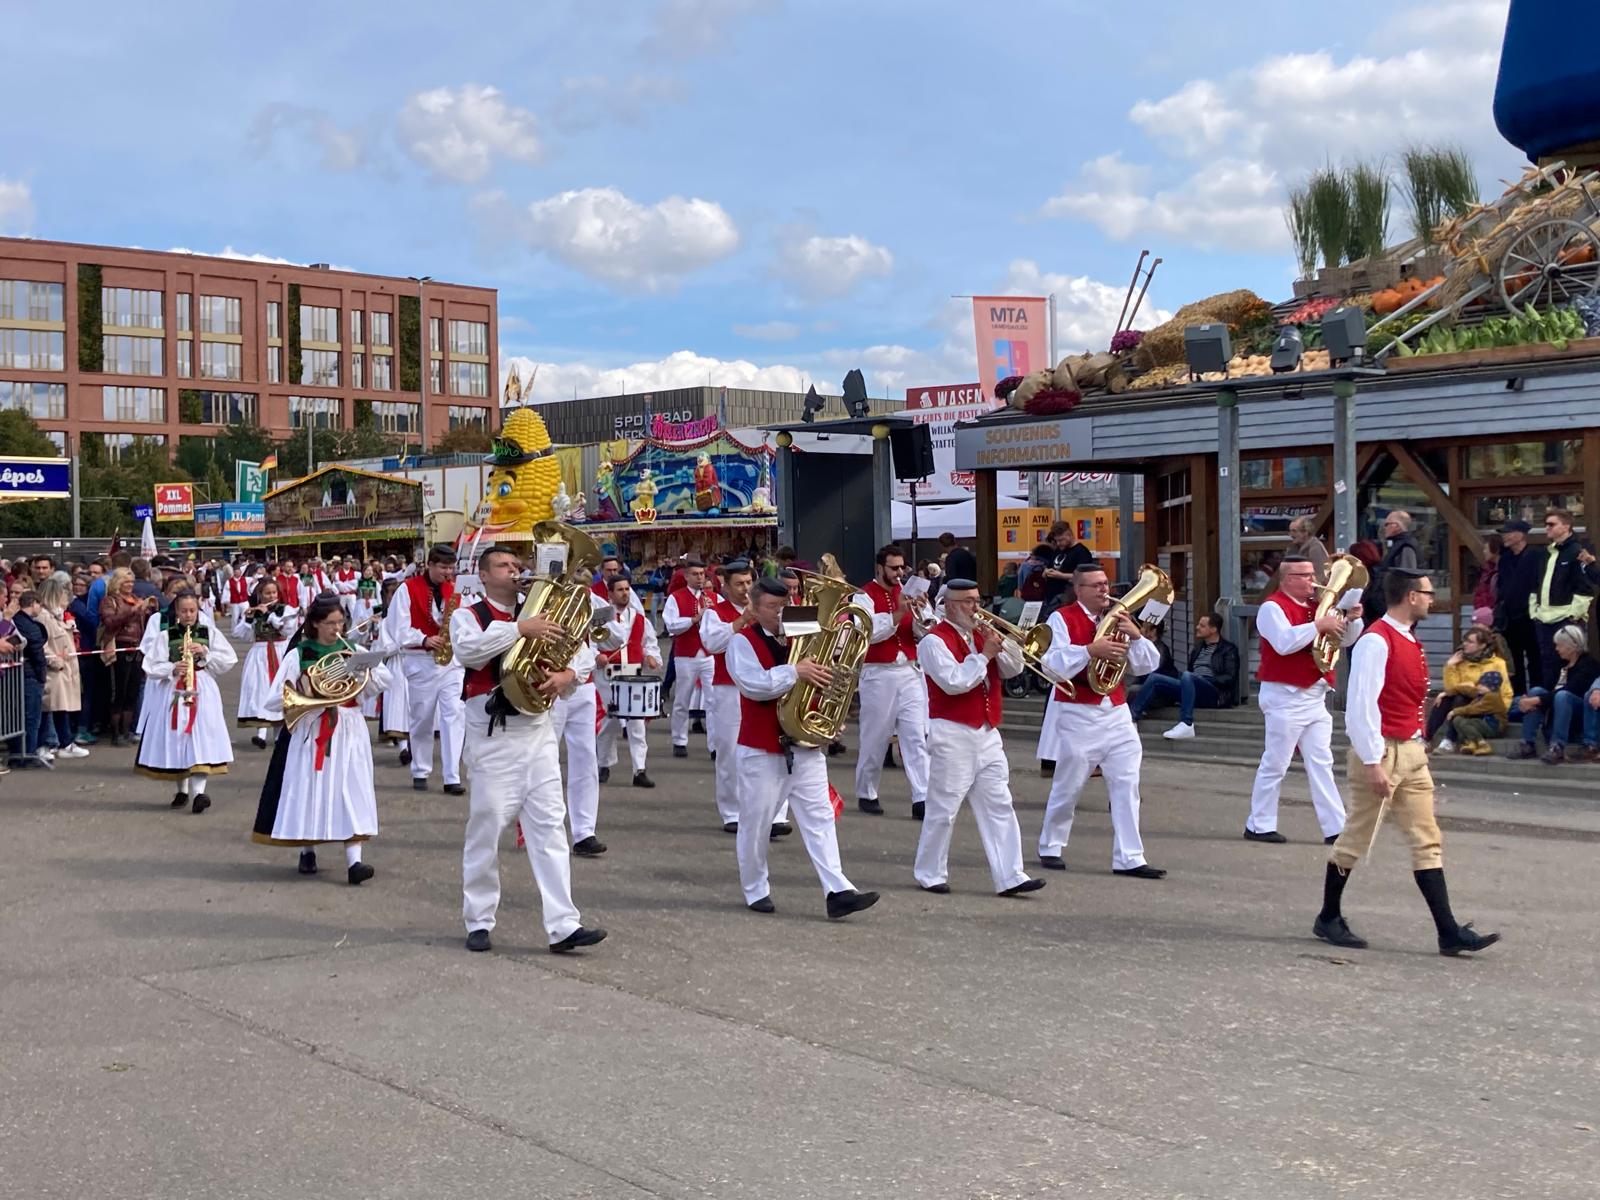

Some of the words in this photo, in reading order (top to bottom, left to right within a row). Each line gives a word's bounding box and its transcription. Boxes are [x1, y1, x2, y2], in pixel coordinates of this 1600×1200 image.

[937, 388, 982, 407] WASEN
[614, 410, 693, 428] SPOBAD
[614, 430, 646, 441] NECK
[985, 424, 1061, 445] SOUVENIRS
[976, 443, 1072, 465] INFORMATION
[0, 467, 45, 488] êpes
[165, 490, 182, 501] XXL
[158, 502, 192, 514] Pommes
[231, 511, 246, 522] XXL
[1002, 515, 1021, 525] ATM
[1032, 515, 1049, 524] ATM
